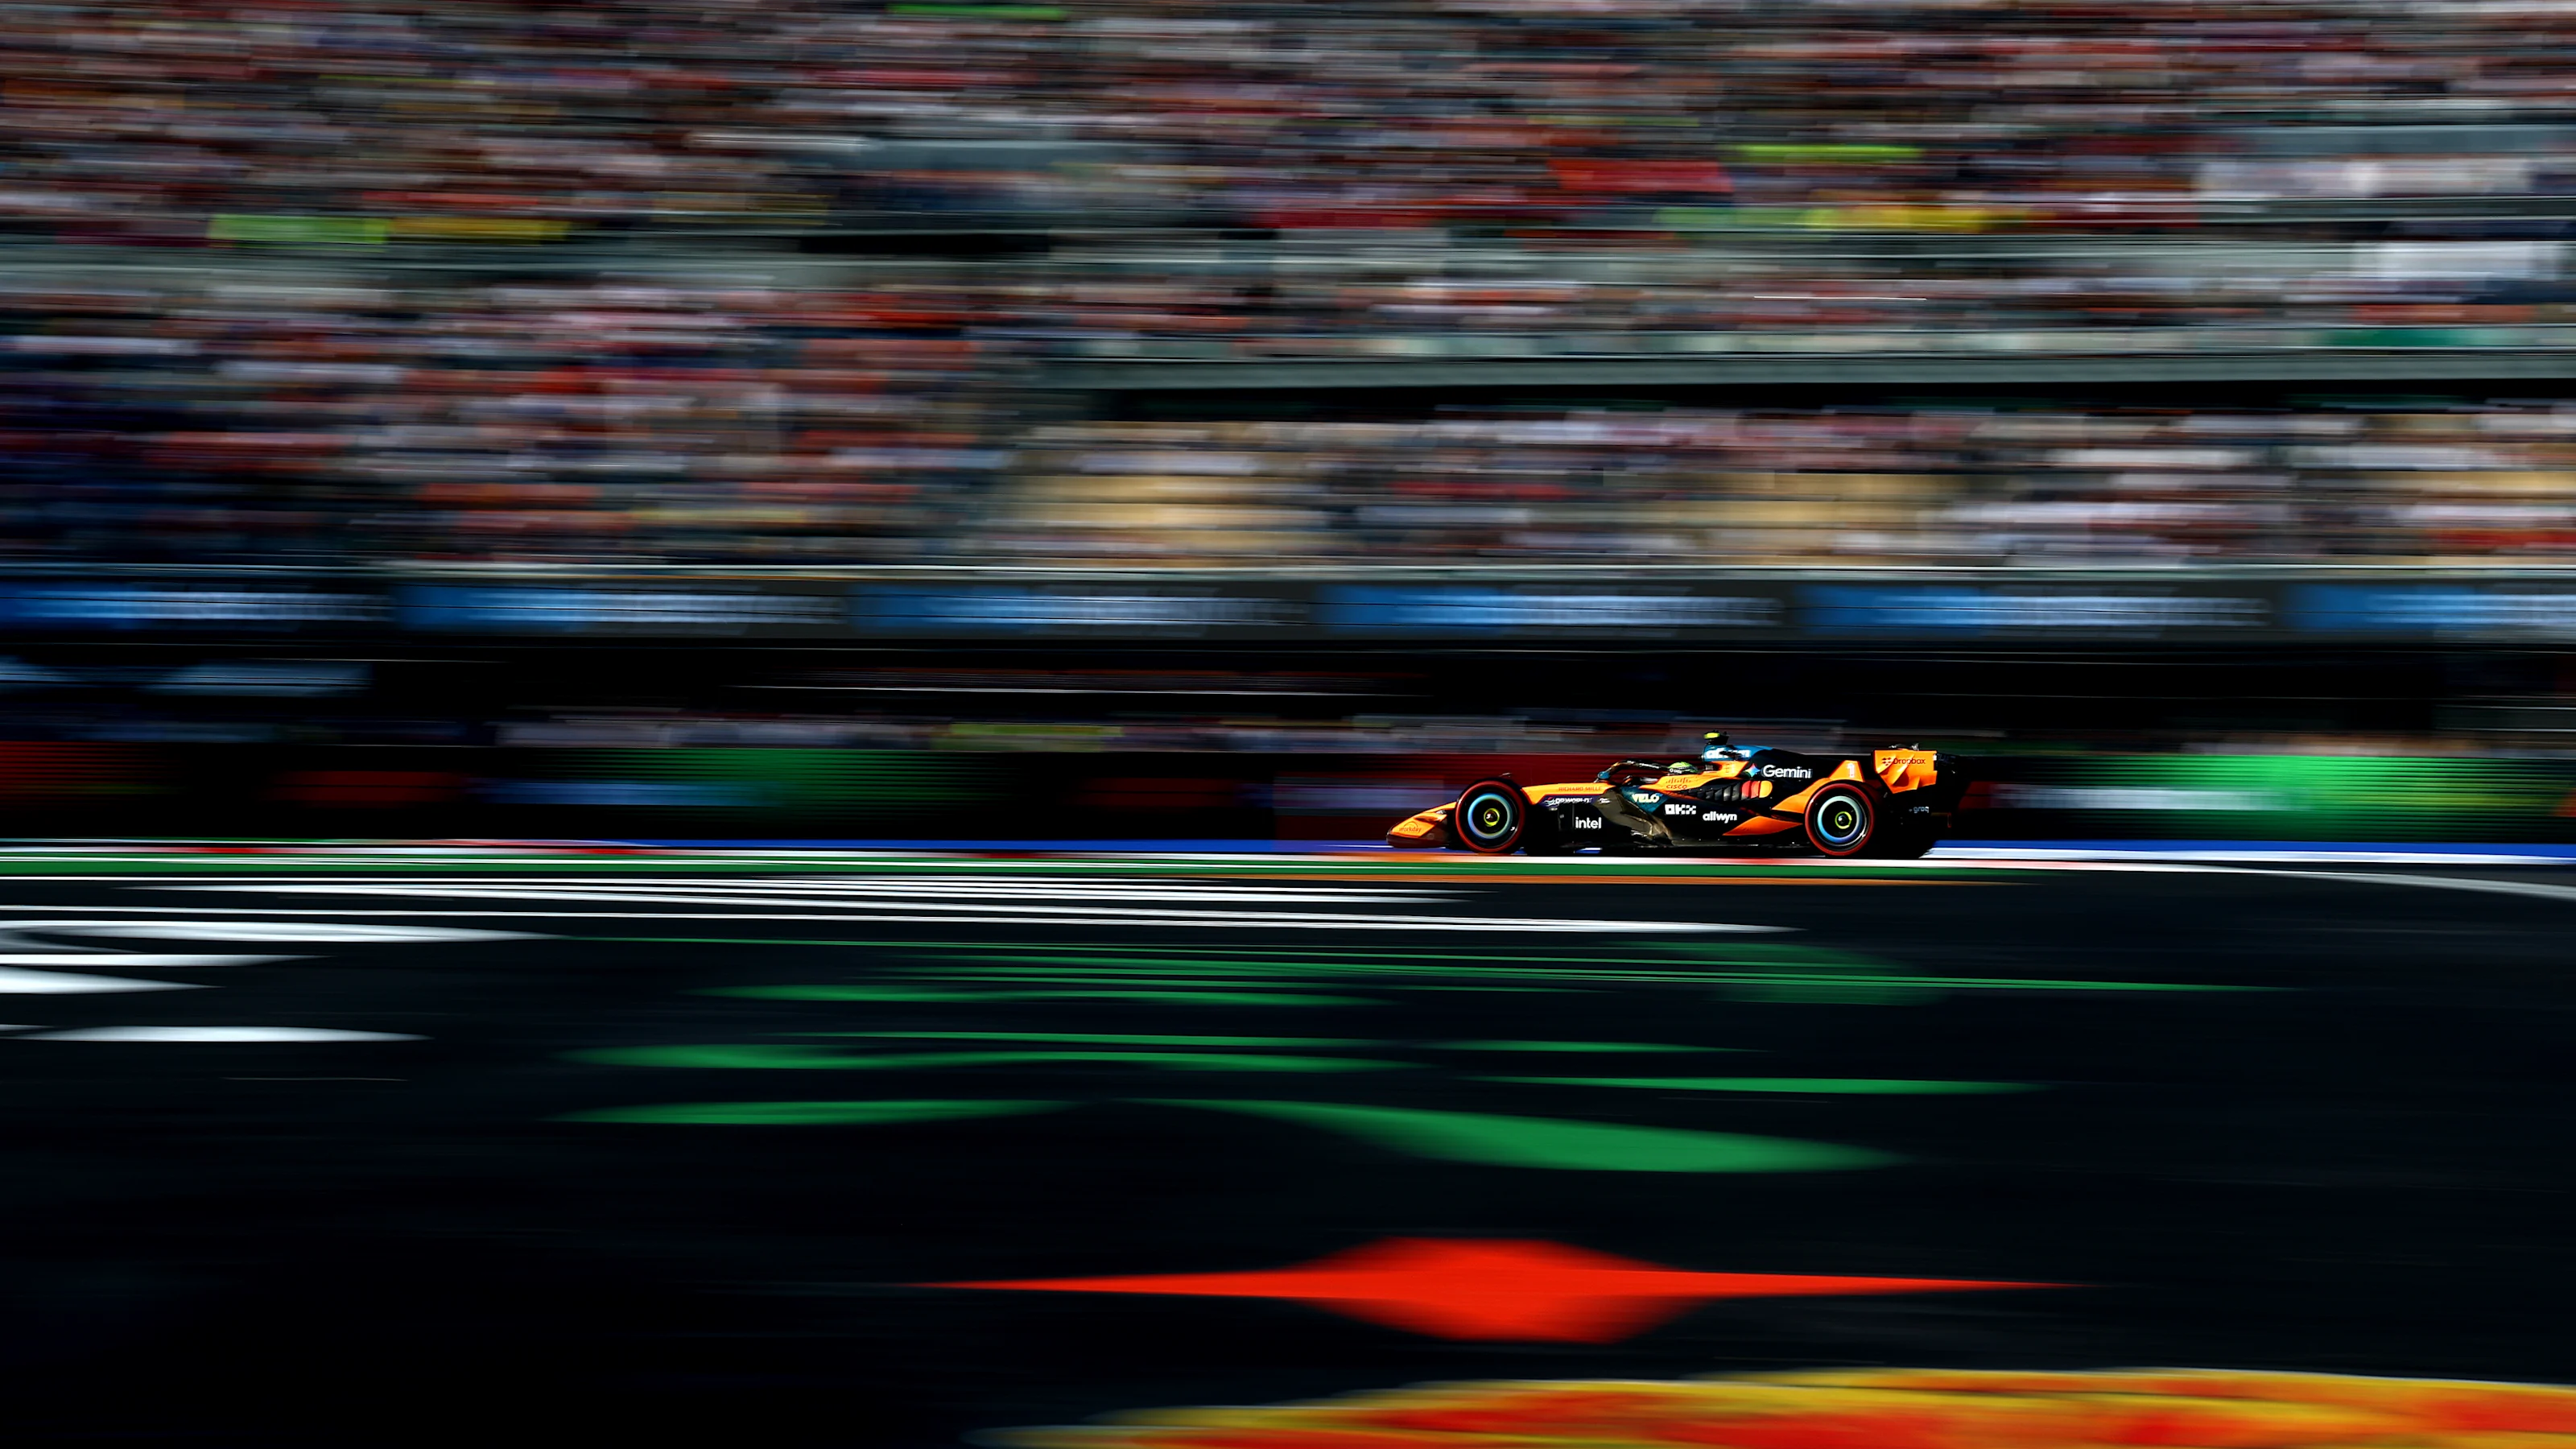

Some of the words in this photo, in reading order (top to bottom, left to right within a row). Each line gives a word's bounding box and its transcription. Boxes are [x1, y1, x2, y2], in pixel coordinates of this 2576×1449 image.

[1763, 764, 1812, 778] Gemini
[1847, 762, 1855, 778] 1
[1632, 793, 1660, 803] VELO
[1665, 804, 1697, 815] OKX
[1913, 806, 1930, 814] groq
[1575, 816, 1602, 829] intel
[1703, 811, 1738, 824] allwyn
